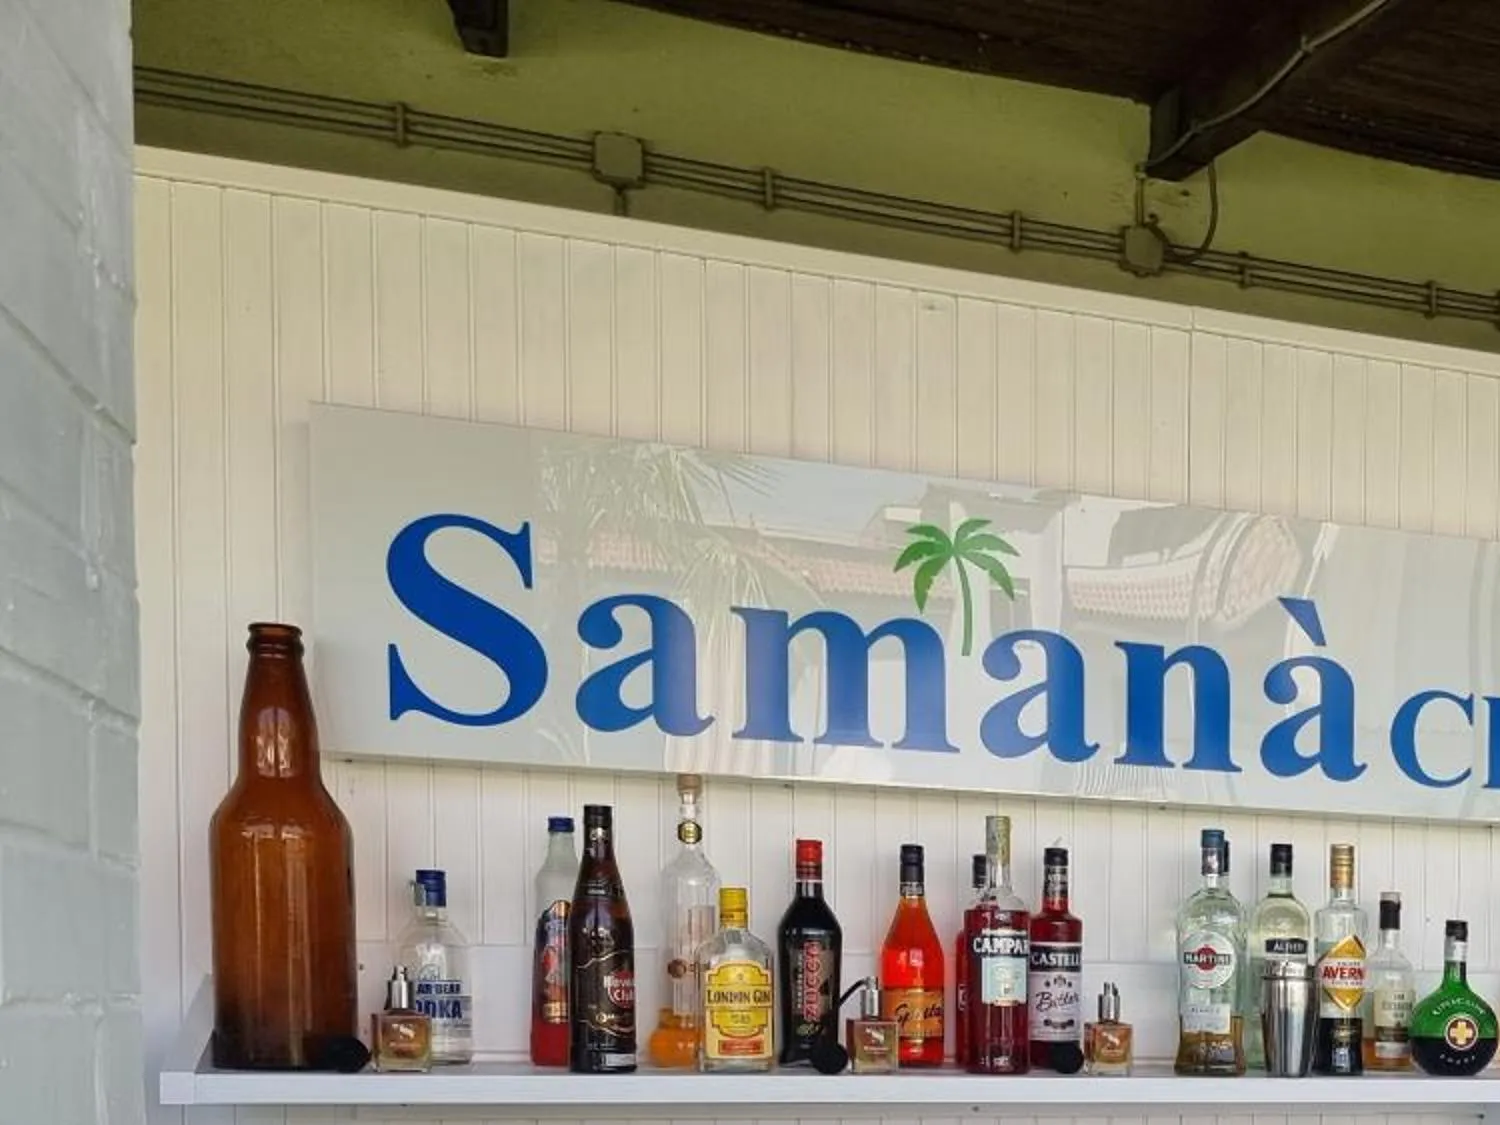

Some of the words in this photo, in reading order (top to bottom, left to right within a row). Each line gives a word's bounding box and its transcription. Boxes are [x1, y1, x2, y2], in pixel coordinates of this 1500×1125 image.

[386, 512, 1369, 782] Samanà
[1322, 966, 1365, 979] AVERN
[707, 990, 751, 1004] LONDON
